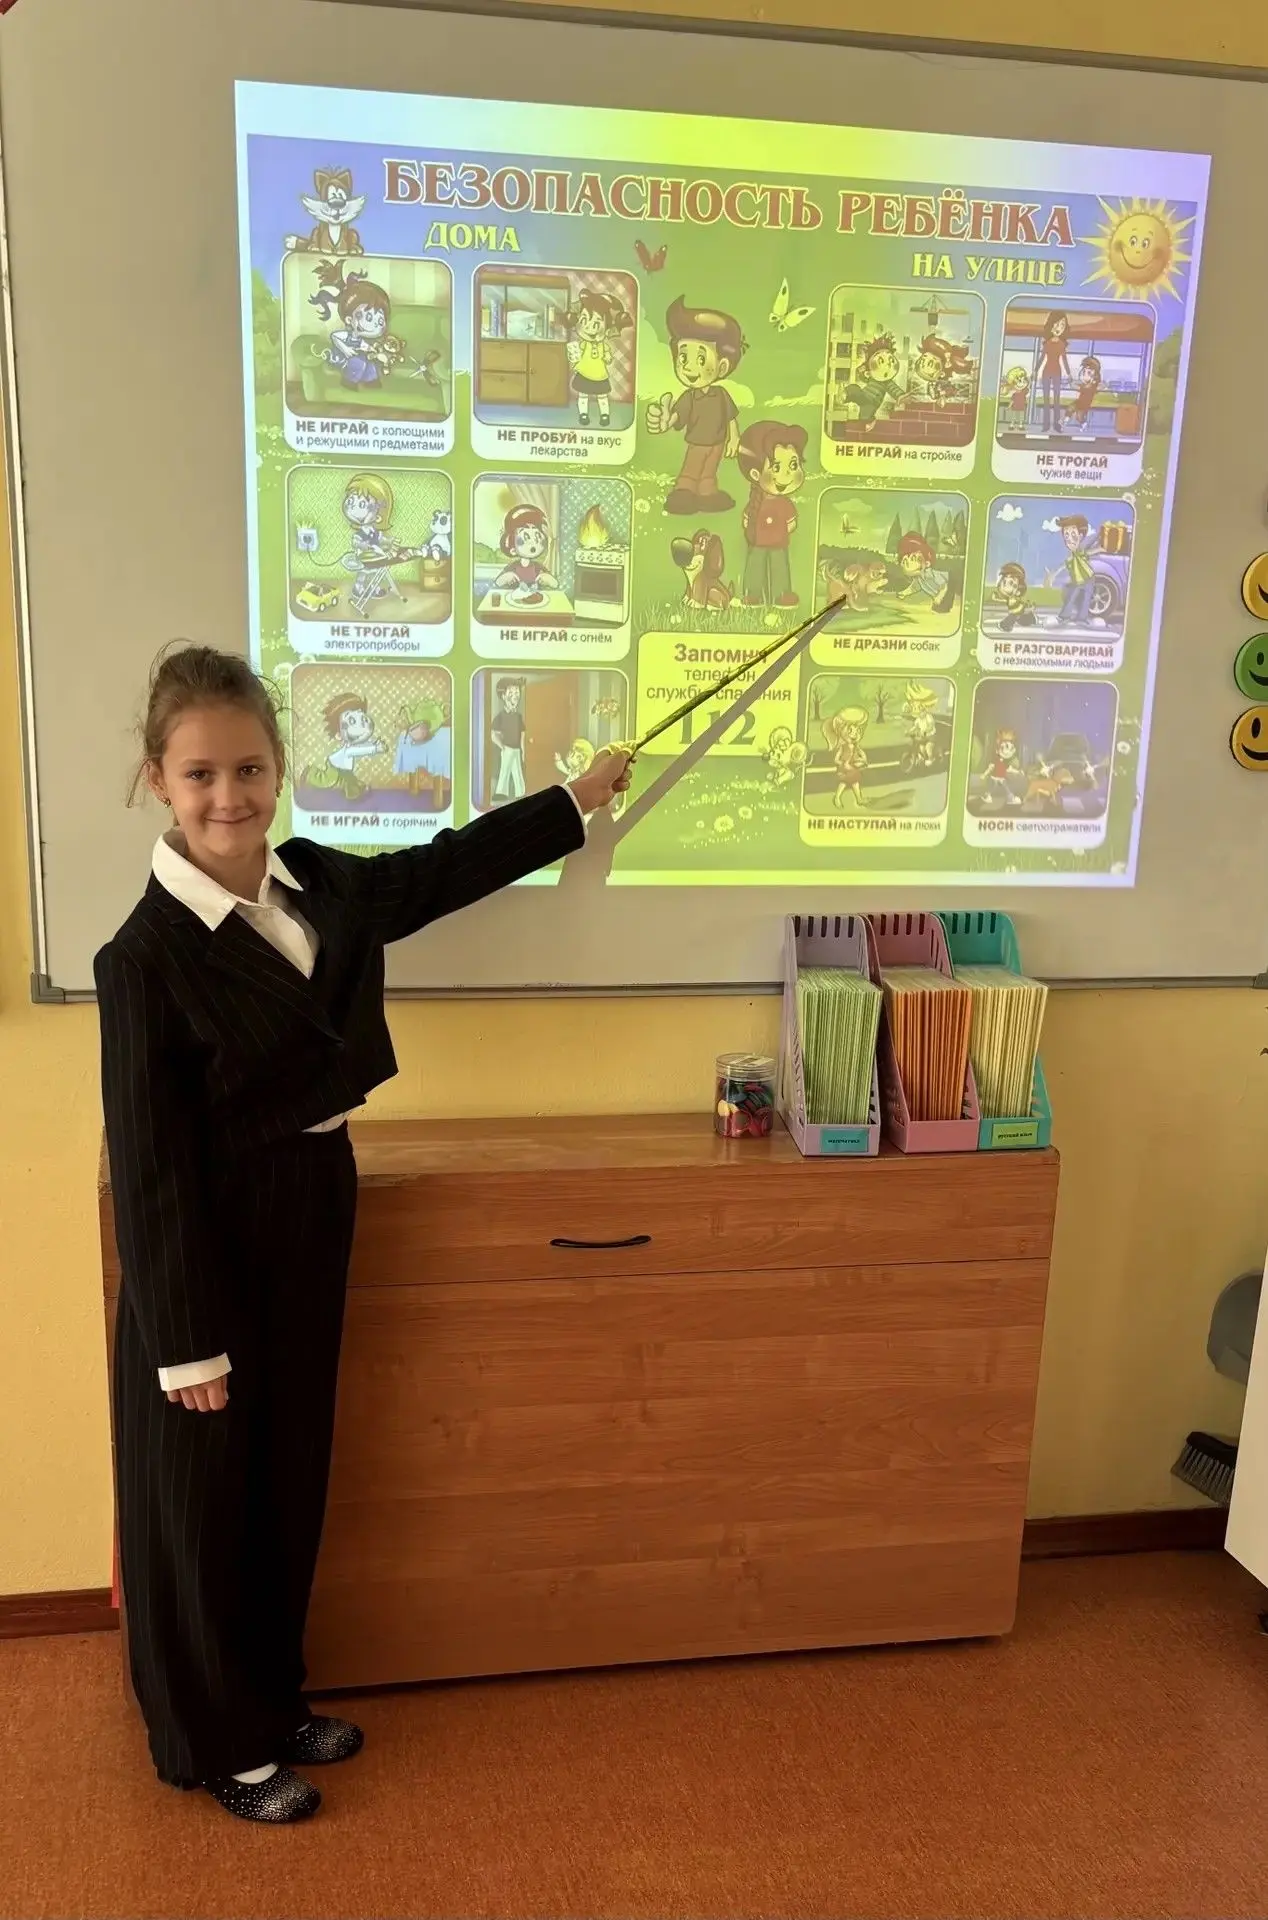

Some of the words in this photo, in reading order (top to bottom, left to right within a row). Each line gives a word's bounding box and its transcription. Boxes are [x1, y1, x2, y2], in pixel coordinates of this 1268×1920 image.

[383, 158, 823, 231] БЕЗОПАСНОСТЬ
[836, 187, 1077, 248] РЕБЁНКА
[424, 221, 521, 254] ДОМА
[912, 252, 955, 280] НА
[964, 256, 1068, 288] УЛИЦЕ
[296, 420, 316, 433] НЕ
[320, 420, 369, 435] ИГРАЙ
[372, 426, 380, 435] с
[382, 426, 445, 438] колющими
[296, 436, 304, 445] и
[307, 436, 370, 449] режущими
[372, 438, 445, 451] предметами
[497, 429, 517, 442] НЕ
[520, 430, 578, 445] ПРОБУЙ
[580, 435, 594, 445] на
[597, 436, 622, 448] вкус
[530, 445, 588, 458] лекарства
[835, 445, 854, 457] НЕ
[857, 445, 902, 459] ИГРАЙ
[904, 451, 917, 460] на
[920, 450, 962, 462] стройке
[1036, 454, 1054, 466] НЕ
[1057, 455, 1108, 468] ТРОГАЙ
[1040, 469, 1072, 480] чужие
[1074, 470, 1102, 482] вещи
[331, 625, 350, 637] НЕ
[354, 625, 410, 638] ТРОГАЙ
[500, 629, 519, 641] НЕ
[523, 629, 568, 642] ИГРАЙ
[571, 633, 578, 642] с
[580, 633, 613, 643] огнём
[324, 639, 420, 652] электроприборы
[833, 638, 851, 649] НЕ
[854, 638, 908, 652] ДРАЗНИ
[910, 640, 940, 652] собак
[994, 643, 1011, 654] НЕ
[1014, 643, 1114, 657] РАЗГОВАРИВАЙ
[994, 656, 1001, 665] с
[1003, 656, 1072, 669] незнакомыми
[646, 684, 707, 703] служб
[715, 688, 792, 701] спания
[311, 815, 330, 827] НЕ
[334, 814, 380, 827] ИГРАЙ
[808, 819, 825, 830] НЕ
[829, 818, 897, 830] НАСТУПАЙ
[900, 821, 912, 831] на
